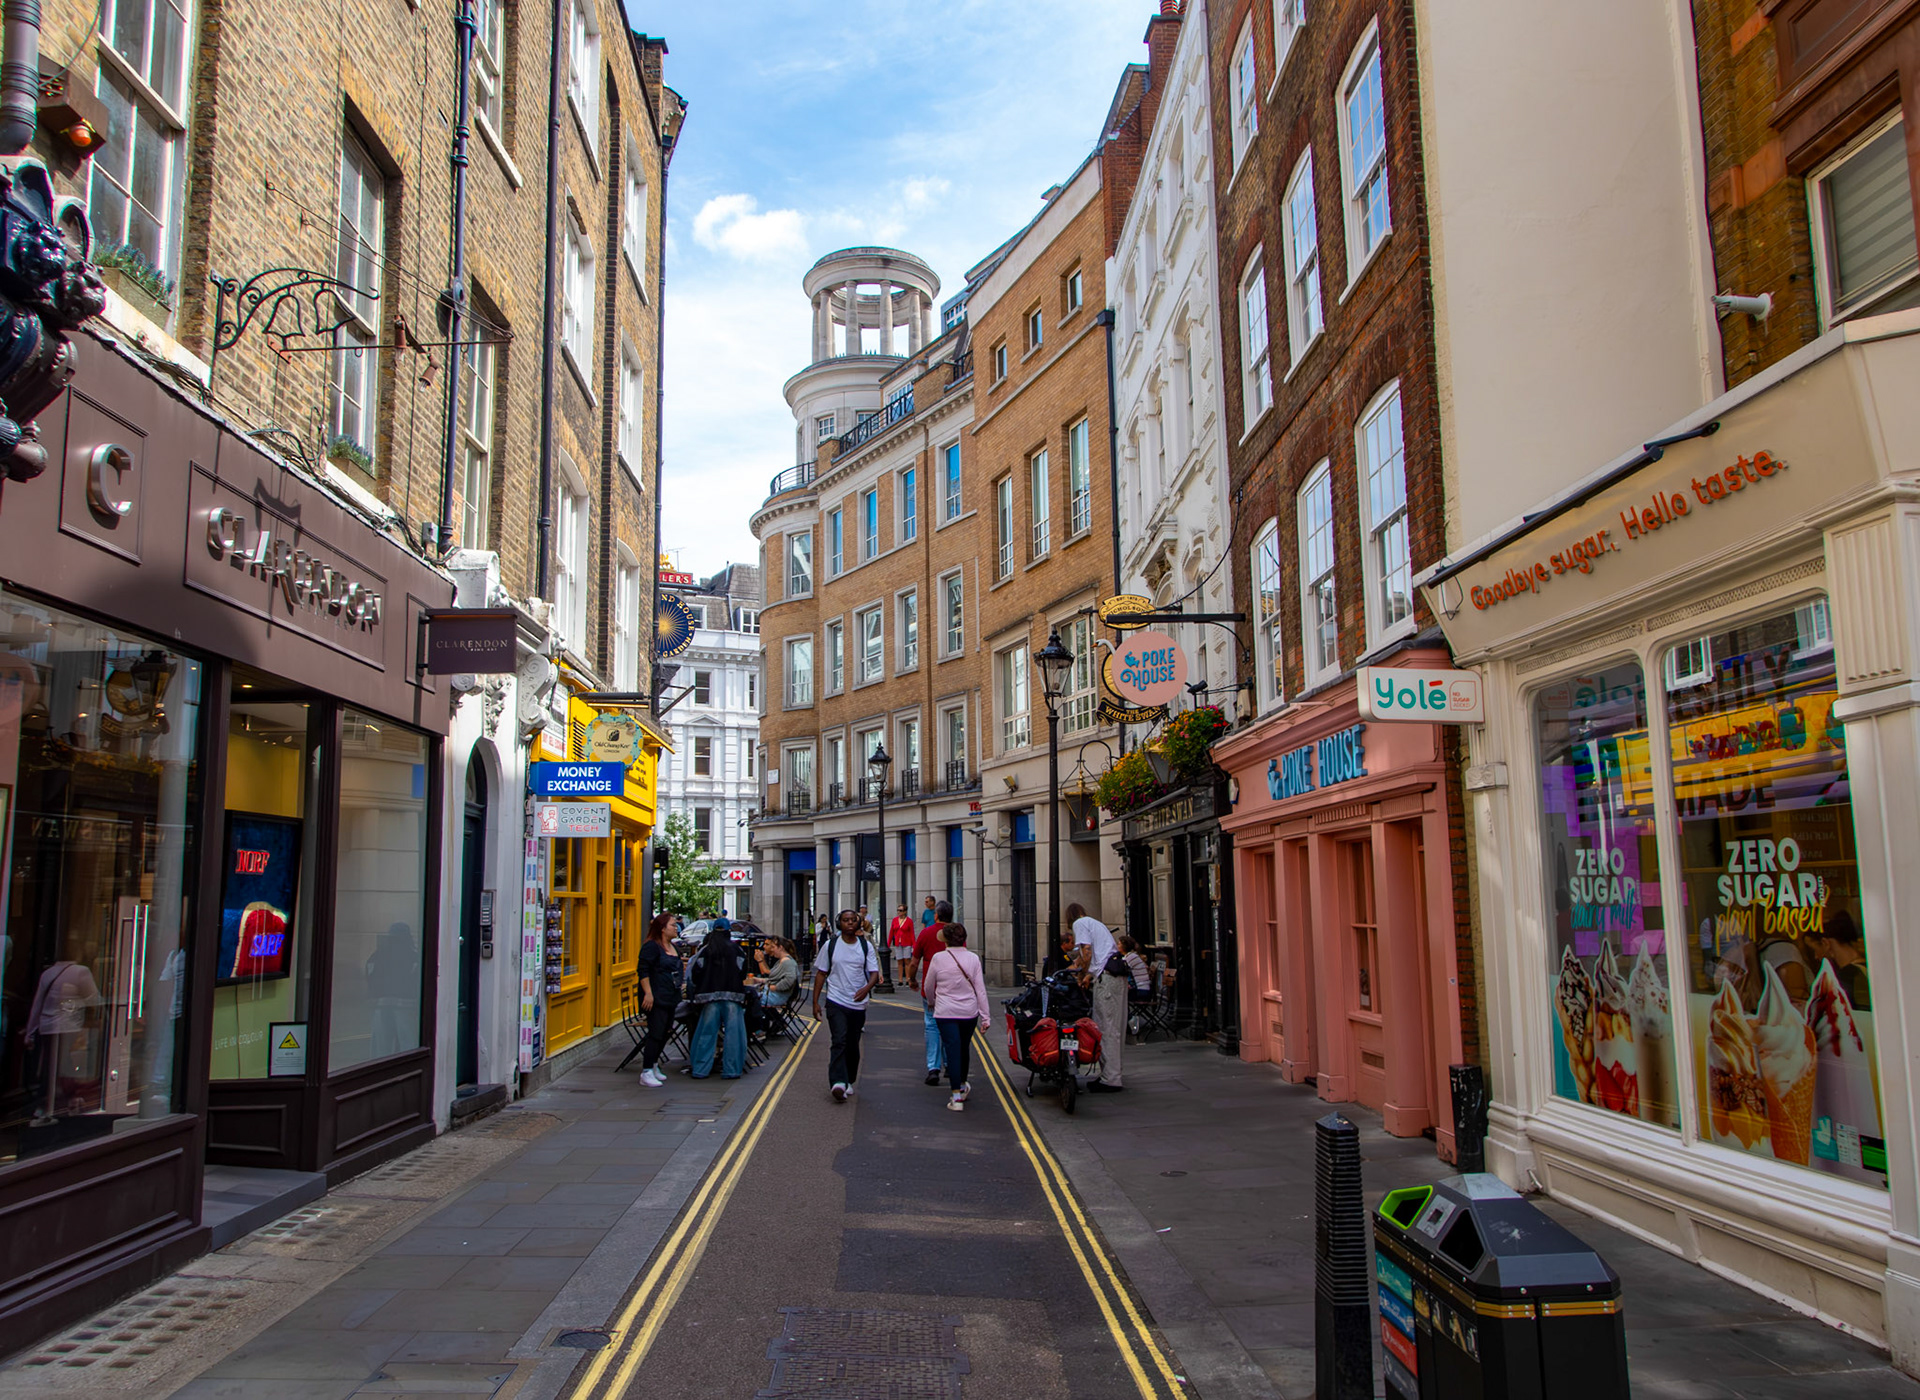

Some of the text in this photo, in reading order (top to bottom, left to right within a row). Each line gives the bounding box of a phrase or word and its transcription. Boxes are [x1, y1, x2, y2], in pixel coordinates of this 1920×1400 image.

[89, 443, 135, 517] C
[1469, 449, 1785, 612] Goodbye sugar. Hello taste.
[208, 507, 382, 622] CLARENDON
[661, 574, 690, 584] LER'S
[677, 601, 695, 631] HOUSE
[436, 640, 508, 651] CLARENDON
[662, 636, 692, 658] GARDEN
[1142, 647, 1176, 667] POKE
[1120, 665, 1176, 691] HOUSE
[1105, 706, 1160, 721] WHITE SWAN
[557, 767, 602, 777] MONEY
[1281, 724, 1369, 798] POKE HOUSE
[547, 780, 612, 791] EXCHANGE
[235, 849, 270, 874] NORF
[1575, 847, 1625, 875] ZERO
[1725, 837, 1801, 873] ZERO
[1569, 876, 1636, 904] SUGAR
[1717, 872, 1817, 907] SUGAR
[1570, 895, 1606, 935] dairy
[1610, 888, 1637, 930] milk
[1715, 885, 1830, 957] plant based
[250, 934, 285, 957] SARF
